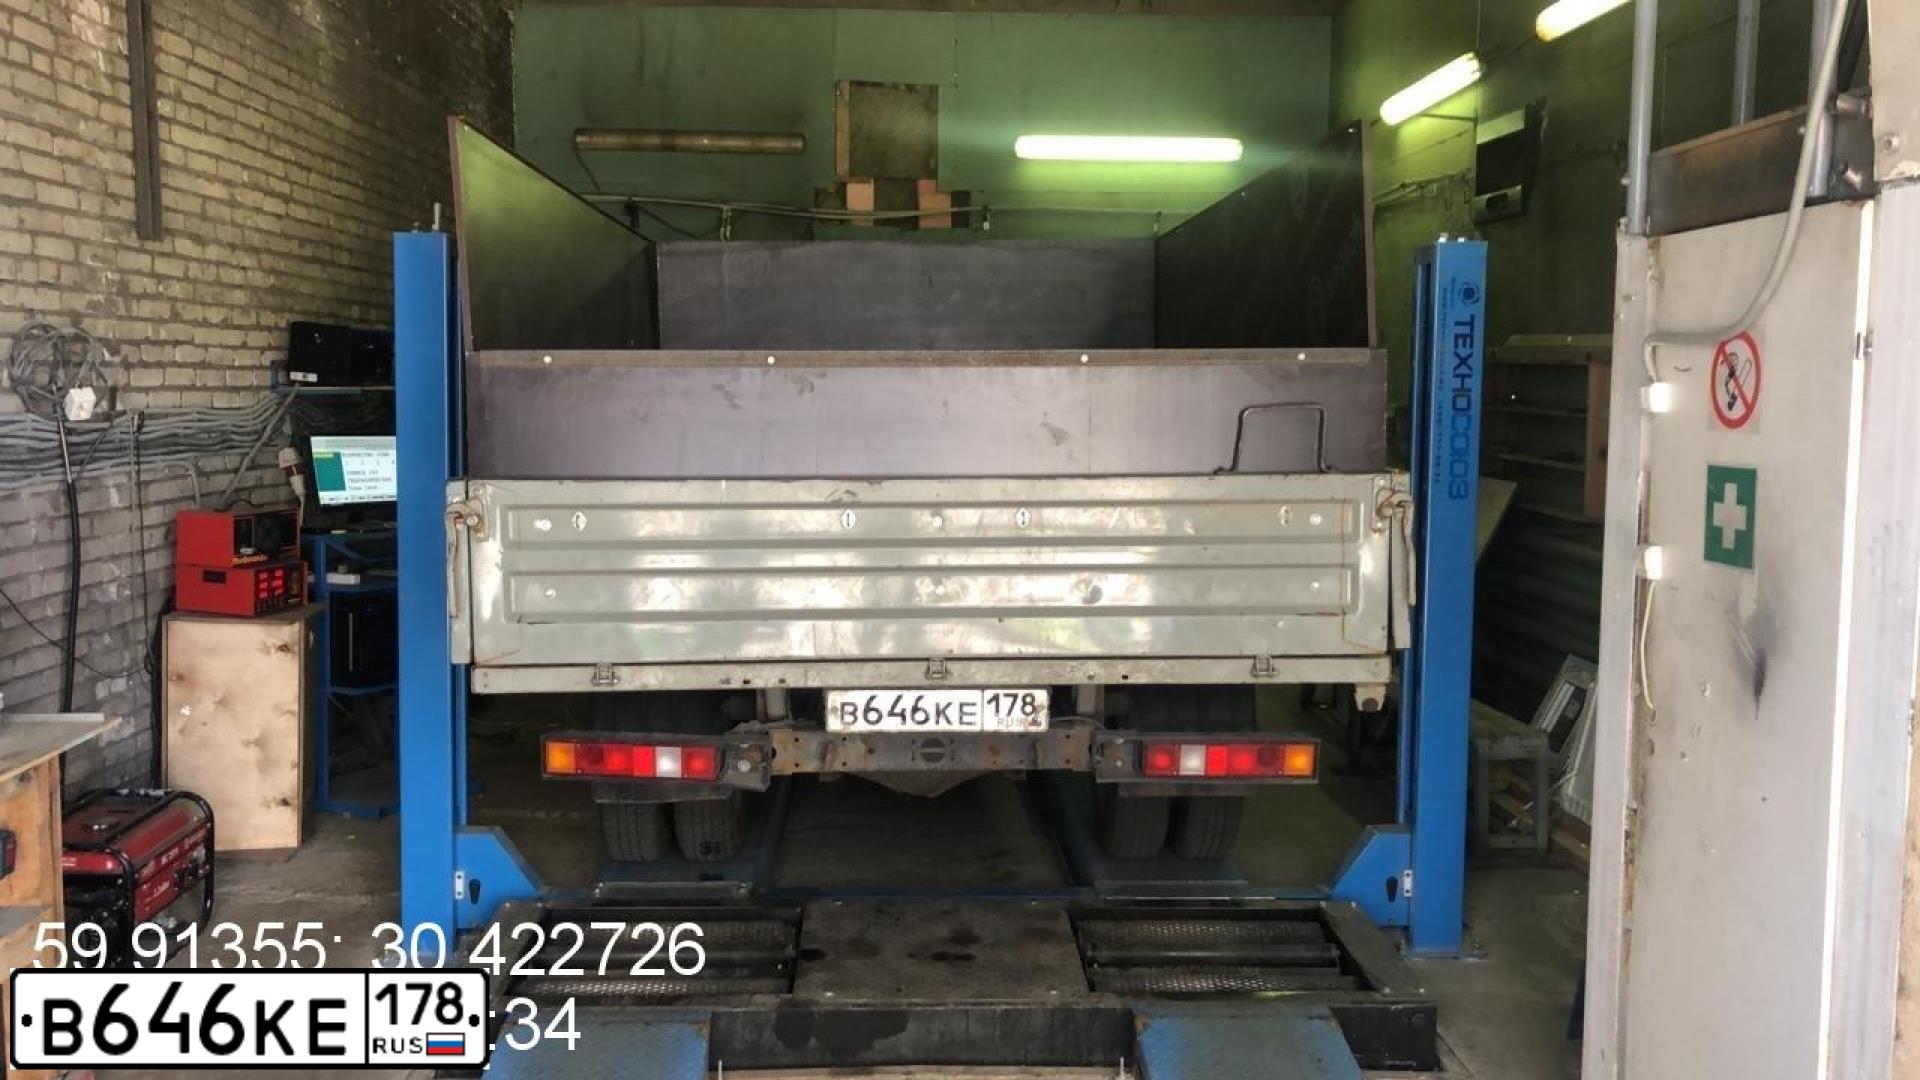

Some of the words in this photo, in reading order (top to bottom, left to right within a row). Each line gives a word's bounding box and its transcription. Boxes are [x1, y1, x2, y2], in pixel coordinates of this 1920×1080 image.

[1449, 313, 1475, 500] ТЕХНОСОЮЗ
[840, 695, 977, 726] В646КЕ
[986, 692, 1036, 717] 178
